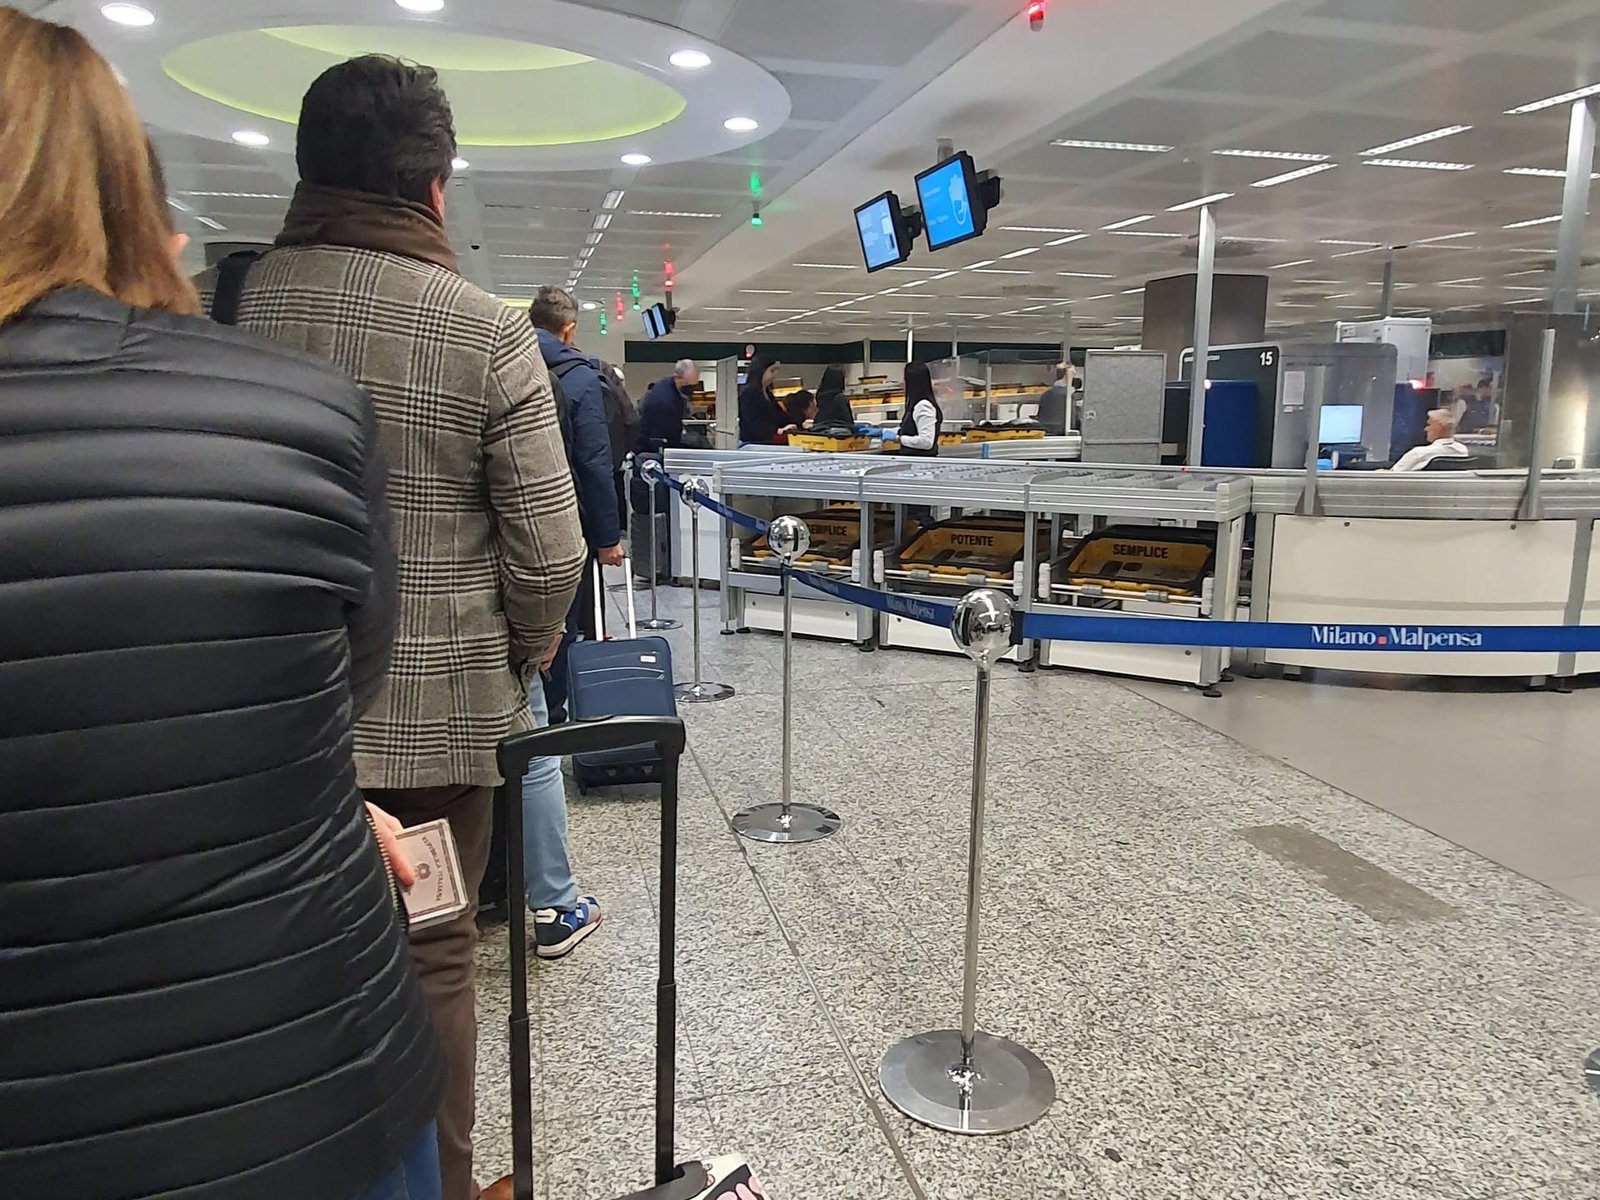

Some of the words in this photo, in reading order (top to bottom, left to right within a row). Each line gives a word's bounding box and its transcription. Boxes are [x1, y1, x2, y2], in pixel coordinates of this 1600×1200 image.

[1260, 351, 1273, 366] 15
[809, 524, 848, 537] EMPLICE
[951, 533, 994, 547] POTENTE
[1113, 543, 1169, 559] SEMPLICE
[1311, 625, 1376, 646] Milano
[1389, 627, 1482, 650] Malpensa
